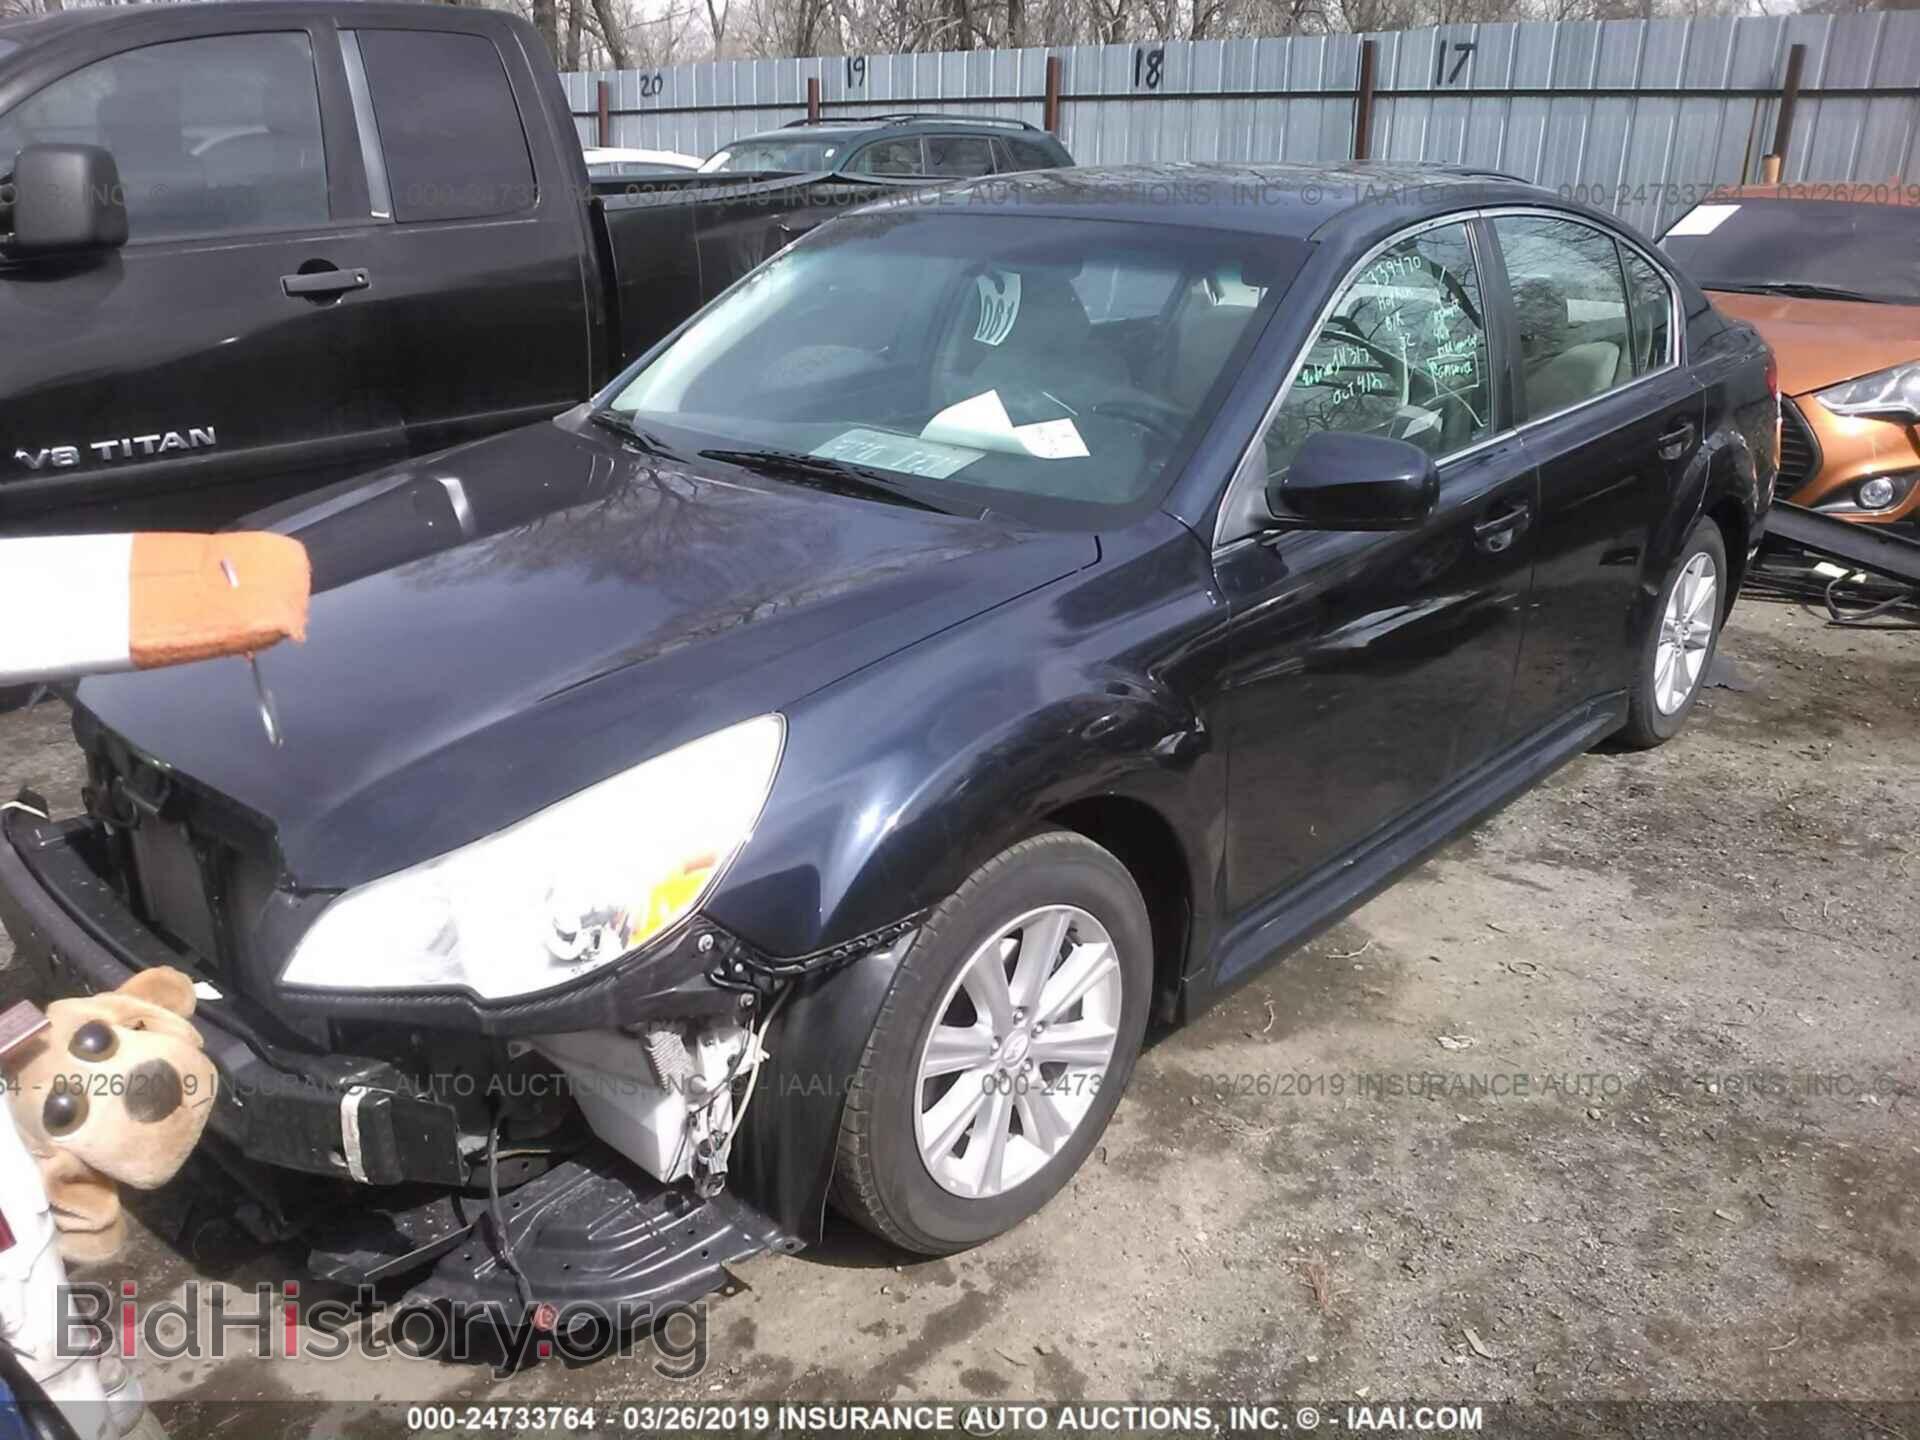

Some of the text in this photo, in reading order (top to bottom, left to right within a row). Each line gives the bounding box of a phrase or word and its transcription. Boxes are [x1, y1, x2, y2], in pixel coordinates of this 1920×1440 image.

[846, 56, 866, 88] 19
[1135, 47, 1164, 89] 18
[1436, 40, 1477, 86] 17
[640, 73, 663, 97] 20
[14, 426, 216, 470] V8 TITAN
